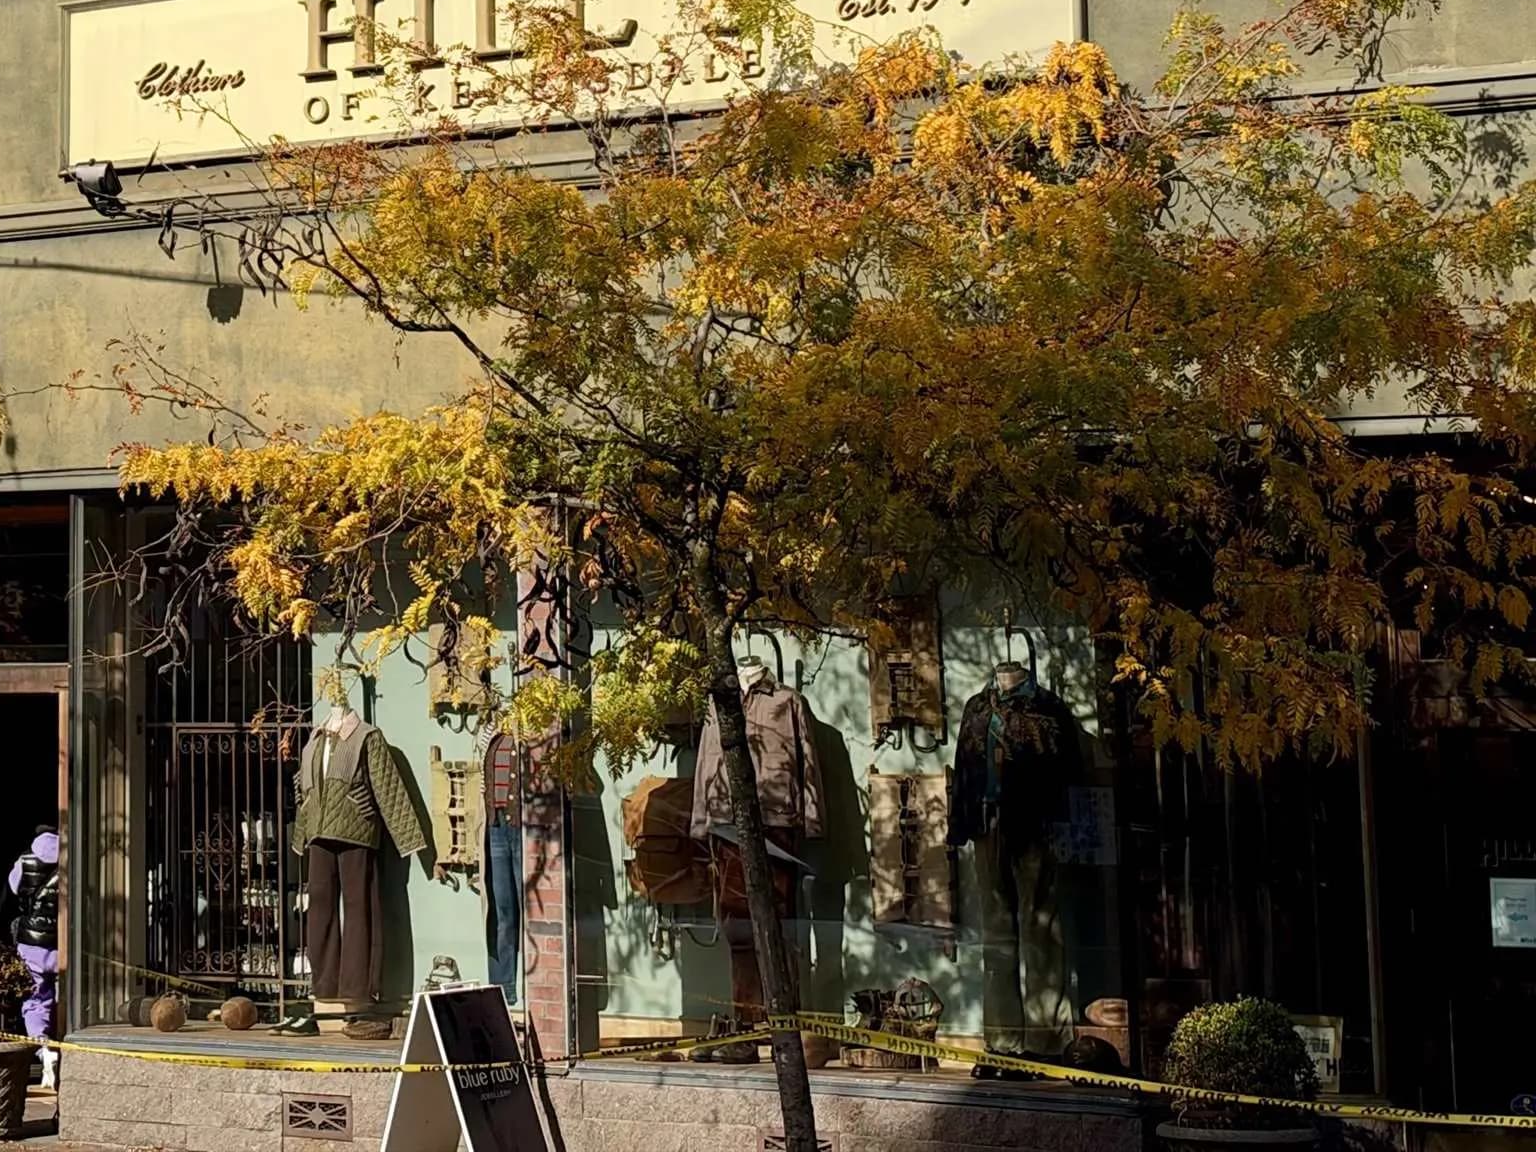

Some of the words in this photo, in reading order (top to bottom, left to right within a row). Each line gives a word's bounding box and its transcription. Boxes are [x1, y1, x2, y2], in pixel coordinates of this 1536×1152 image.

[134, 59, 246, 100] Clothiers
[304, 92, 361, 125] OF
[457, 1070, 489, 1089] blue
[490, 1065, 520, 1085] ruby
